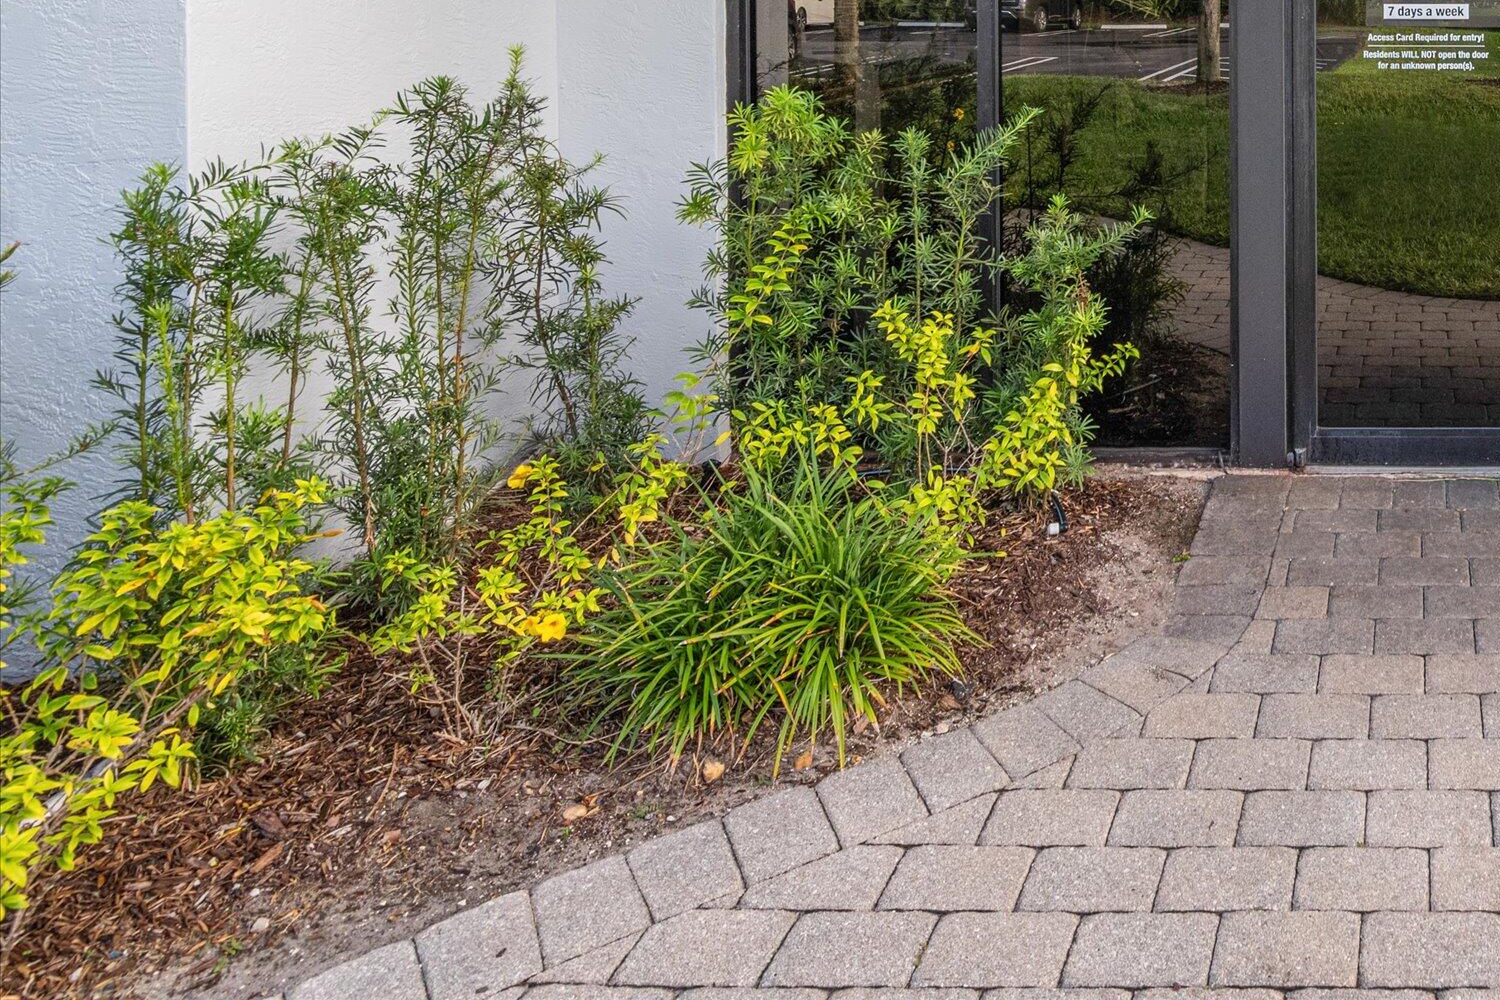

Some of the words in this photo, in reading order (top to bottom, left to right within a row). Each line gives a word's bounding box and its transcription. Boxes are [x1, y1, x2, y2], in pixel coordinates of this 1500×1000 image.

[1388, 6, 1394, 16] 7
[1398, 6, 1423, 18] days
[1426, 8, 1432, 16] a
[1436, 6, 1464, 16] week
[1416, 34, 1448, 43] Required
[1462, 34, 1484, 43] entry!
[1364, 50, 1400, 59] Residents
[1402, 51, 1419, 59] WILL
[1421, 51, 1436, 59] NOT
[1438, 52, 1456, 60] open
[1458, 51, 1470, 59] the
[1472, 51, 1489, 59] door
